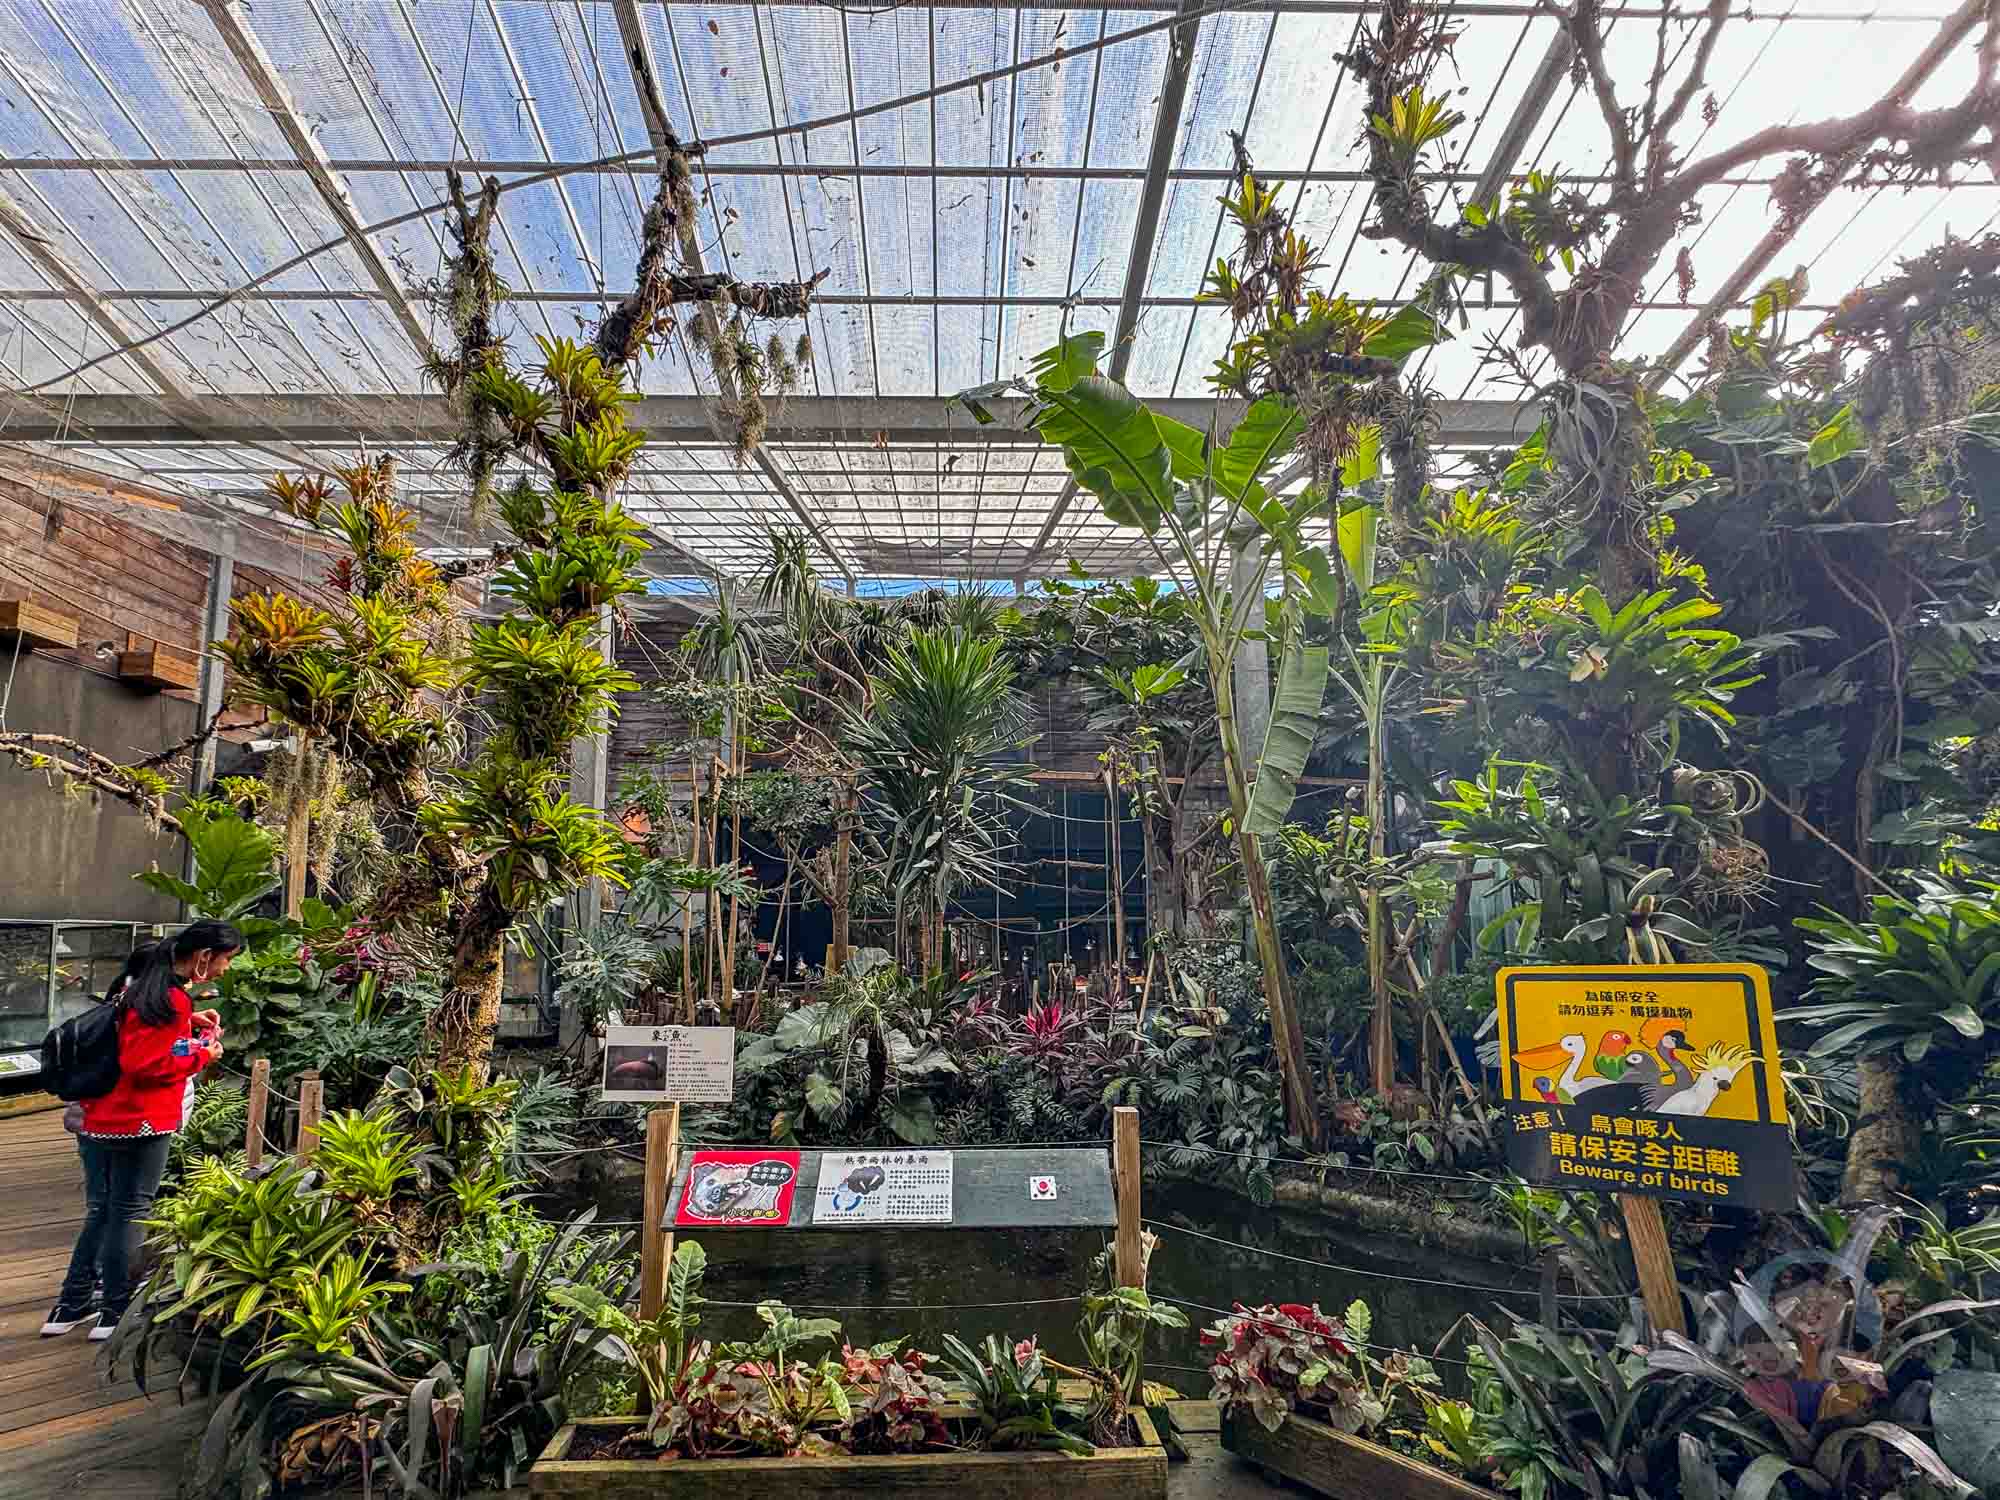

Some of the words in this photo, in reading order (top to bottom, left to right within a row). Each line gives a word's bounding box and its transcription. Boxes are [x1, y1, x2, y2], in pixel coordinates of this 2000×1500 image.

[1585, 991, 1658, 1003] 為確保安全
[1591, 1114, 1684, 1141] 鳥會啄人
[1550, 1132, 1742, 1177] 請保安全距離
[1559, 1159, 1637, 1184] Beware
[1641, 1170, 1664, 1186] of
[1669, 1172, 1729, 1196] birds
